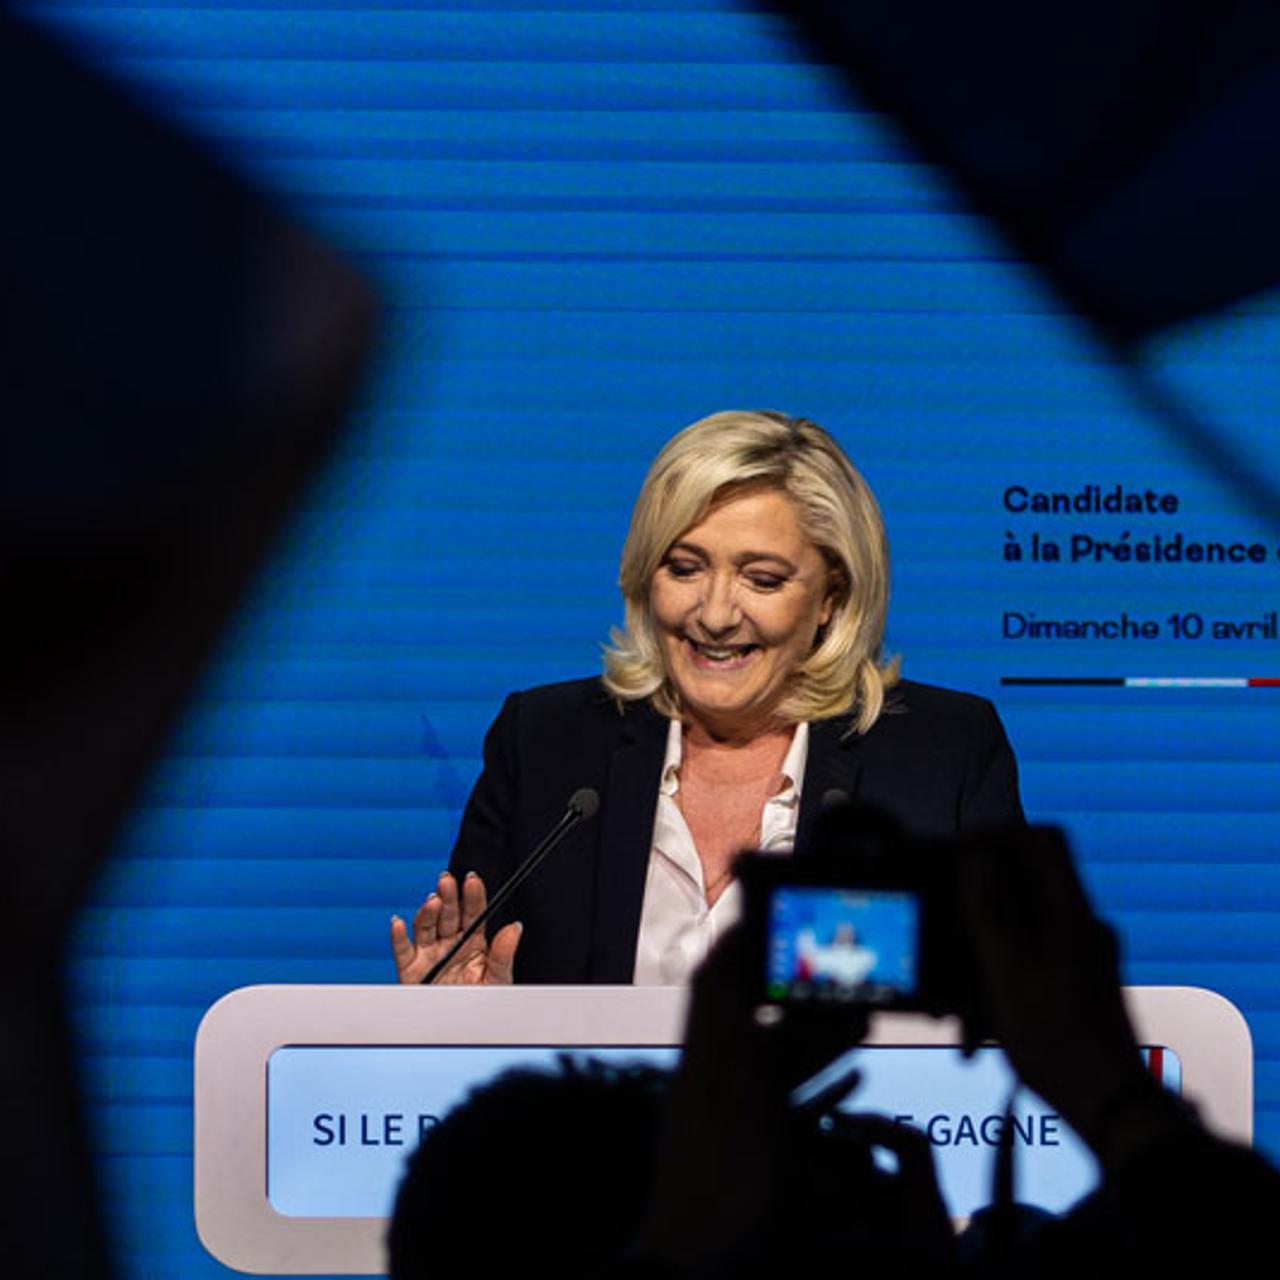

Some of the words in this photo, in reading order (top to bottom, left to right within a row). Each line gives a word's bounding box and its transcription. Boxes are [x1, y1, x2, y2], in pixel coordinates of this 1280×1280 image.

[1003, 485, 1180, 515] Candidate
[1003, 530, 1023, 562] à
[1031, 532, 1061, 563] la
[1070, 530, 1267, 564] Présidence
[1002, 611, 1160, 641] Dimanche
[1168, 612, 1205, 641] 10
[1211, 611, 1277, 641] avril
[312, 1113, 347, 1147] SI
[360, 1113, 404, 1147] LE
[926, 1114, 1062, 1147] GAGNE
